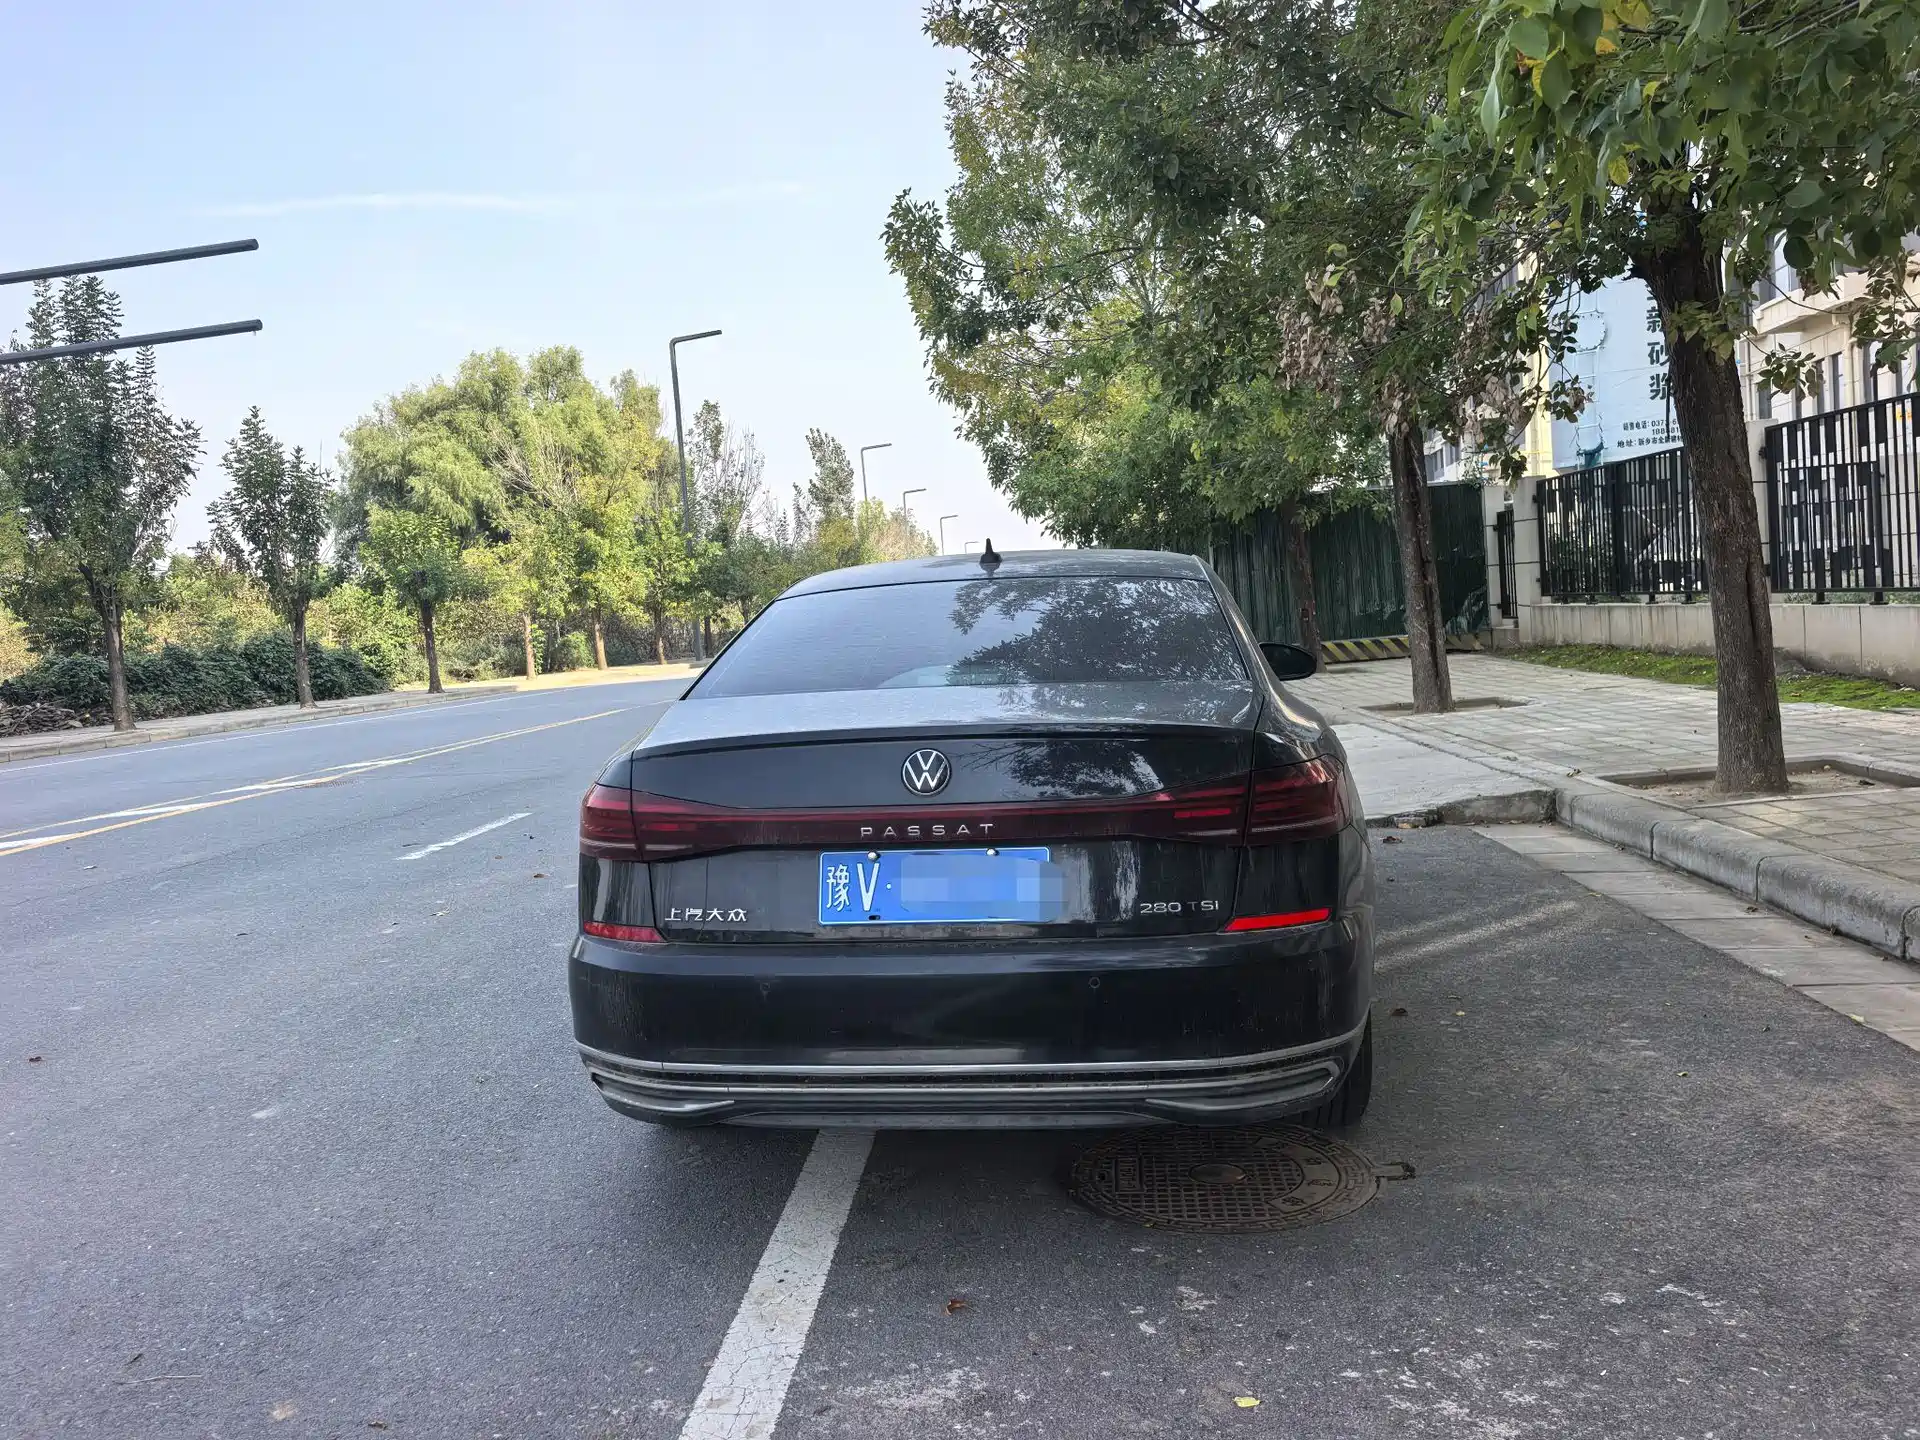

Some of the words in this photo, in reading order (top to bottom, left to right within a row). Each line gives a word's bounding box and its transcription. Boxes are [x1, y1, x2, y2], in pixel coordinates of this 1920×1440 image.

[860, 823, 994, 838] PASSAT
[664, 907, 747, 922] 上汽大众
[1140, 902, 1182, 914] 280
[1187, 900, 1219, 911] TSI
